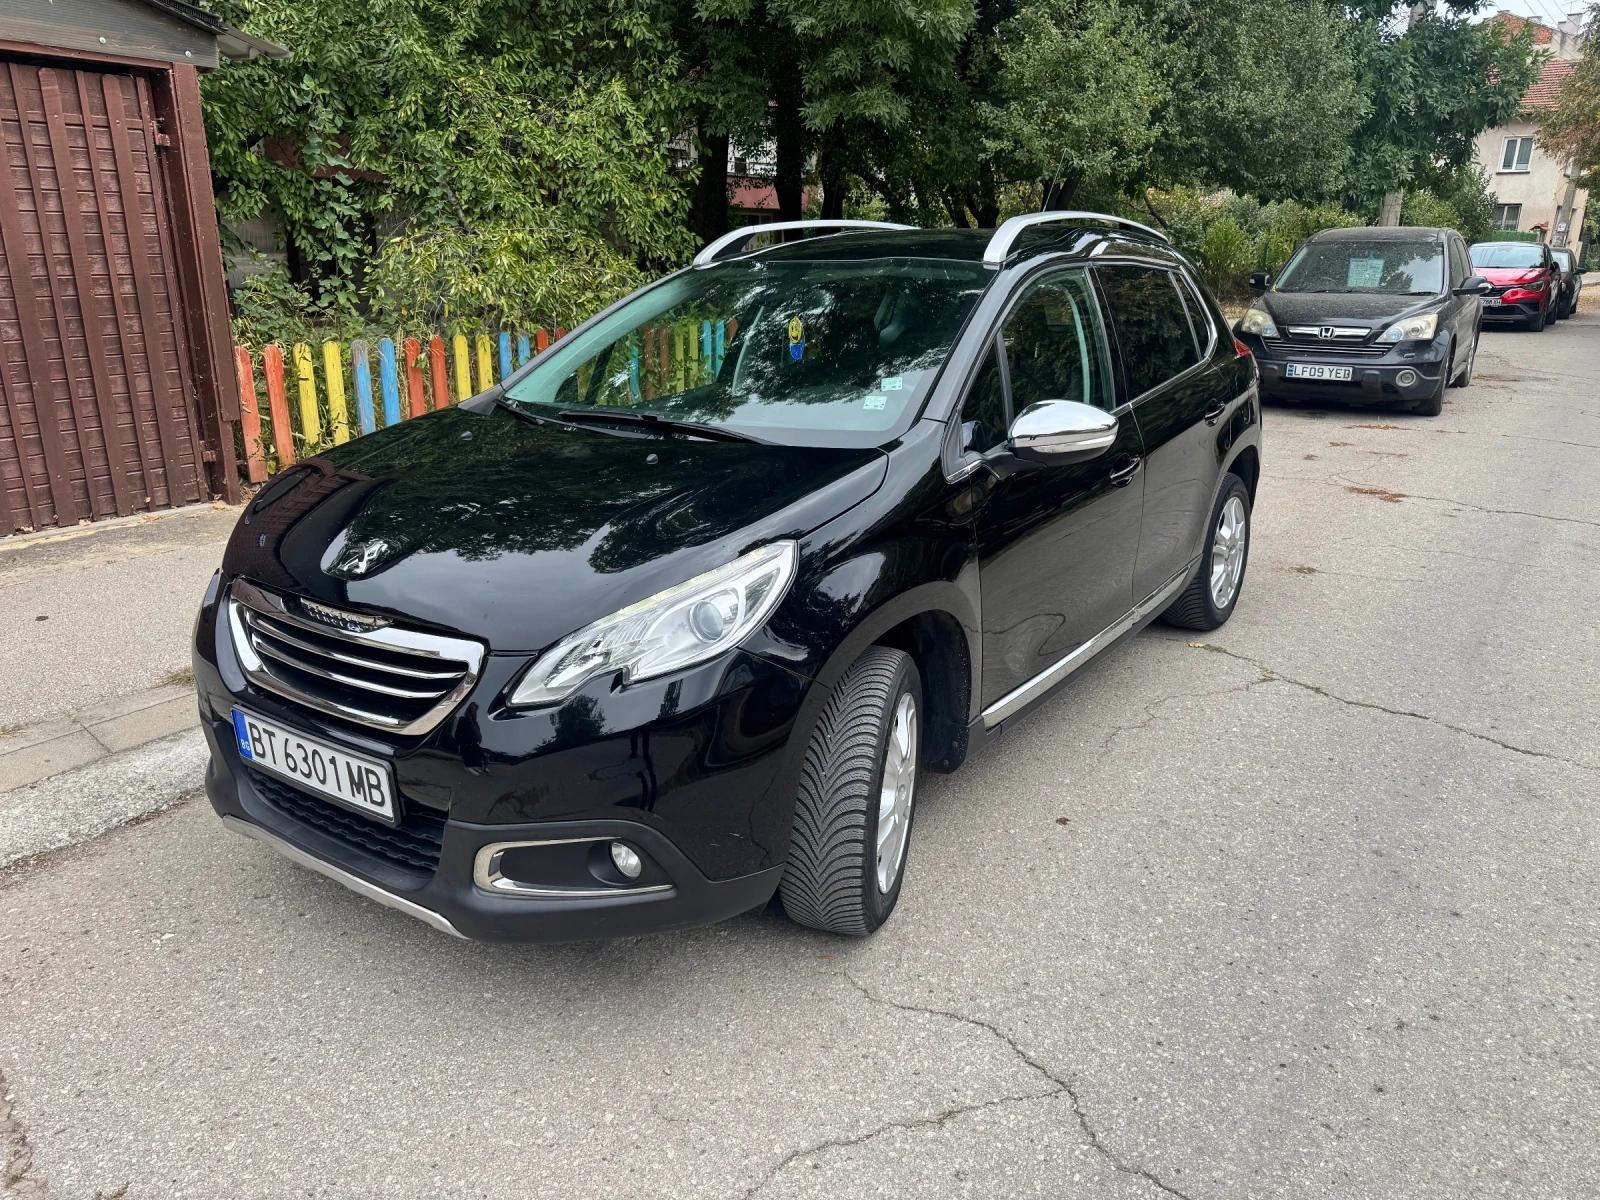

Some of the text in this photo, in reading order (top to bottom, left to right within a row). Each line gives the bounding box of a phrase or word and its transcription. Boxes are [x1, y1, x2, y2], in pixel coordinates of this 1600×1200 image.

[1294, 366, 1324, 377] LF09
[240, 738, 251, 751] BG
[248, 721, 386, 808] BT 6301 MB
